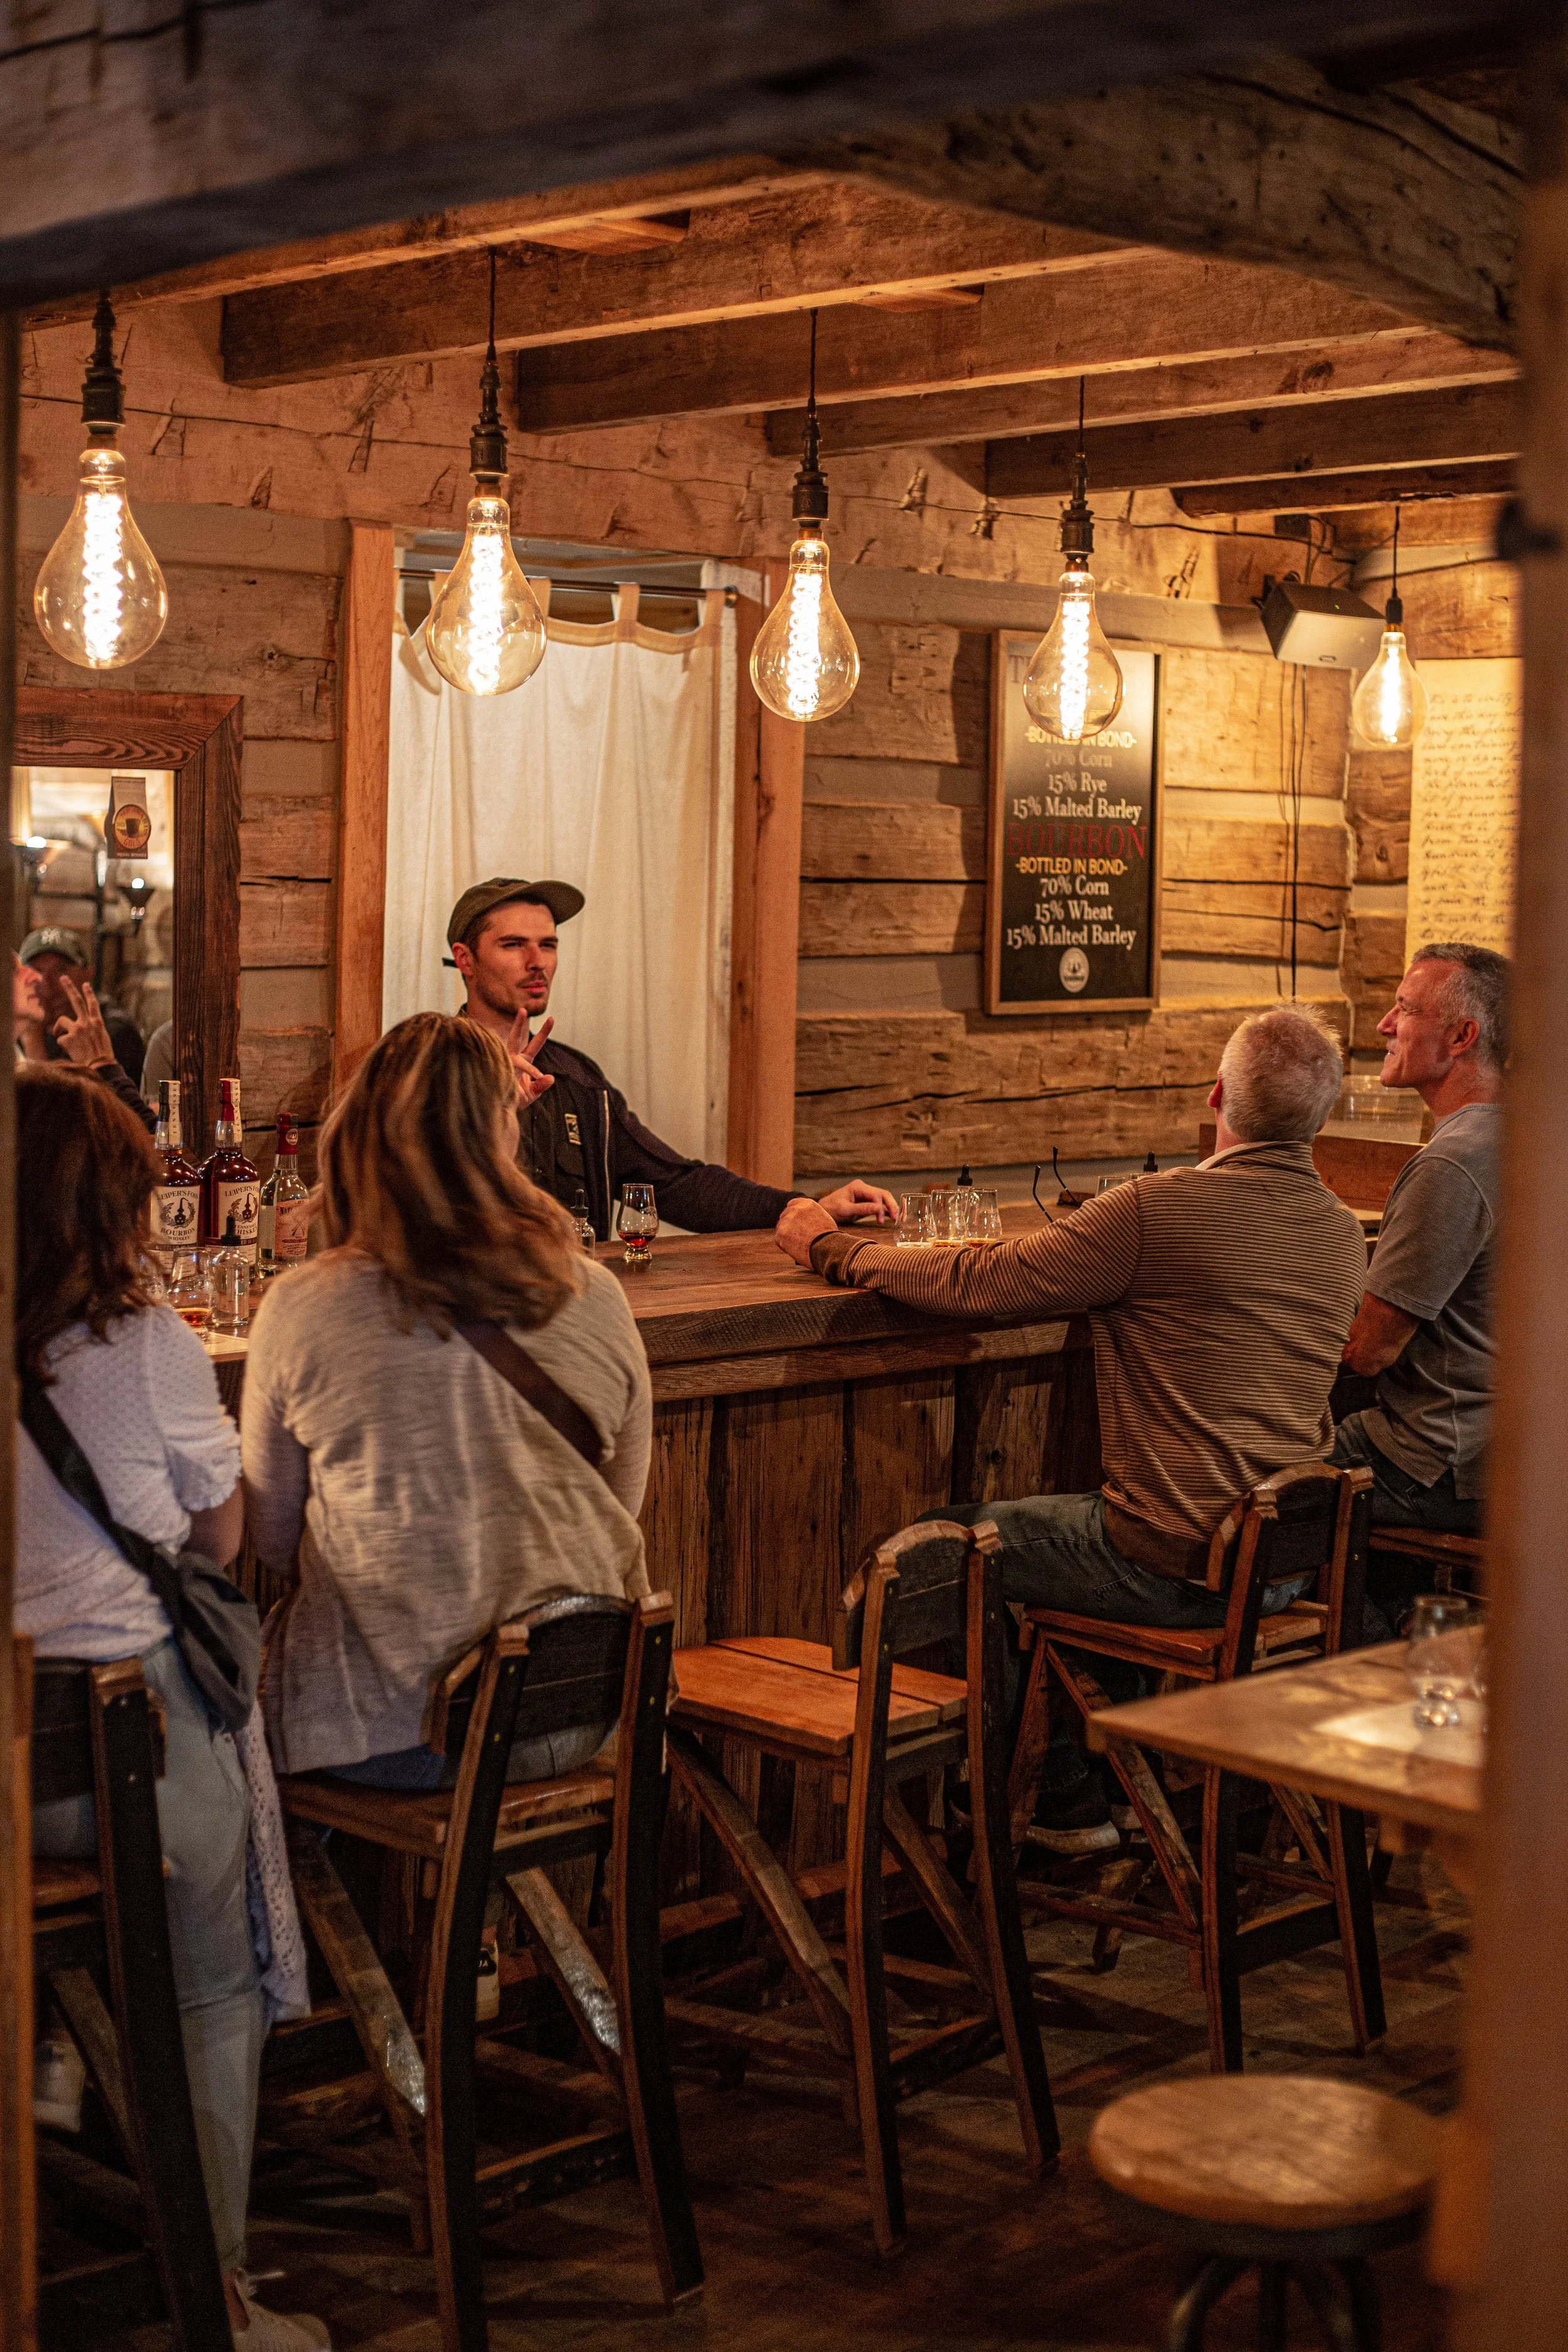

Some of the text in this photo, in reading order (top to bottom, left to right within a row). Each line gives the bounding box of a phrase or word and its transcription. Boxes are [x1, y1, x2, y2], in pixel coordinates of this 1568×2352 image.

[1044, 748, 1113, 768] 70% Corn
[1048, 771, 1107, 798] 15% Rye
[1013, 795, 1143, 826] 15% Malted Barley
[1006, 822, 1148, 859] BOURBON
[1073, 857, 1087, 875] IN
[1039, 874, 1110, 898] 70% Corn
[1035, 899, 1114, 924] 15% Wheat
[1006, 923, 1137, 951] 15% Malted Barley
[225, 1185, 253, 1197] LEIPER'S
[161, 1227, 196, 1237] BOURBON
